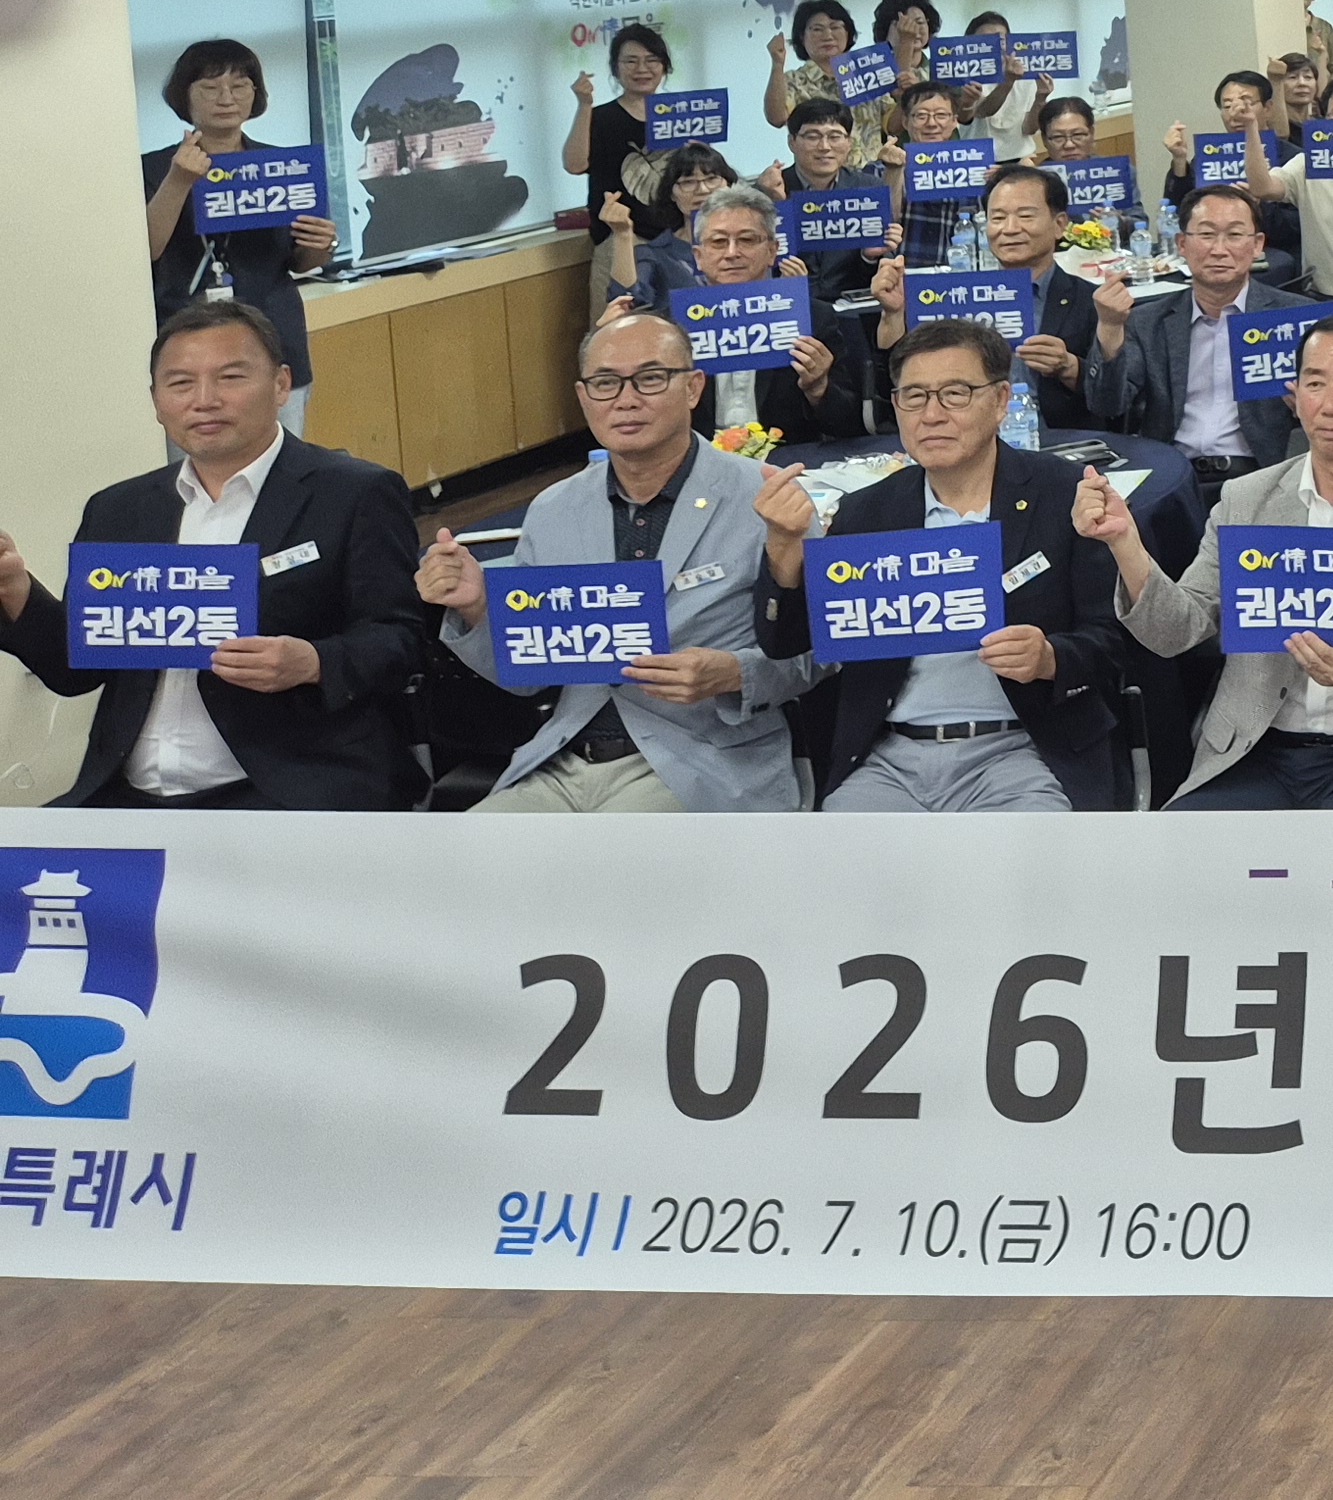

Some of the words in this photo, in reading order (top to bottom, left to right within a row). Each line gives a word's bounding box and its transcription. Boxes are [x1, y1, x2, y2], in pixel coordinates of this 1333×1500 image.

[840, 66, 897, 101] 권선2동
[935, 56, 997, 79] 권선2동
[652, 115, 724, 140] 권선2동
[912, 165, 988, 191] 권선2동
[204, 183, 316, 221] 권선2동
[800, 213, 884, 241] 권선2동
[690, 319, 802, 361] 권선2동
[82, 605, 240, 646] 권선2동
[824, 587, 988, 639] 권선2동
[505, 621, 654, 666] 권선2동
[501, 950, 1310, 1156] 2026년
[493, 1189, 601, 1257] 일시
[640, 1195, 793, 1257] 2026.
[819, 1199, 864, 1259] 7.
[1095, 1200, 1252, 1261] 16:00
